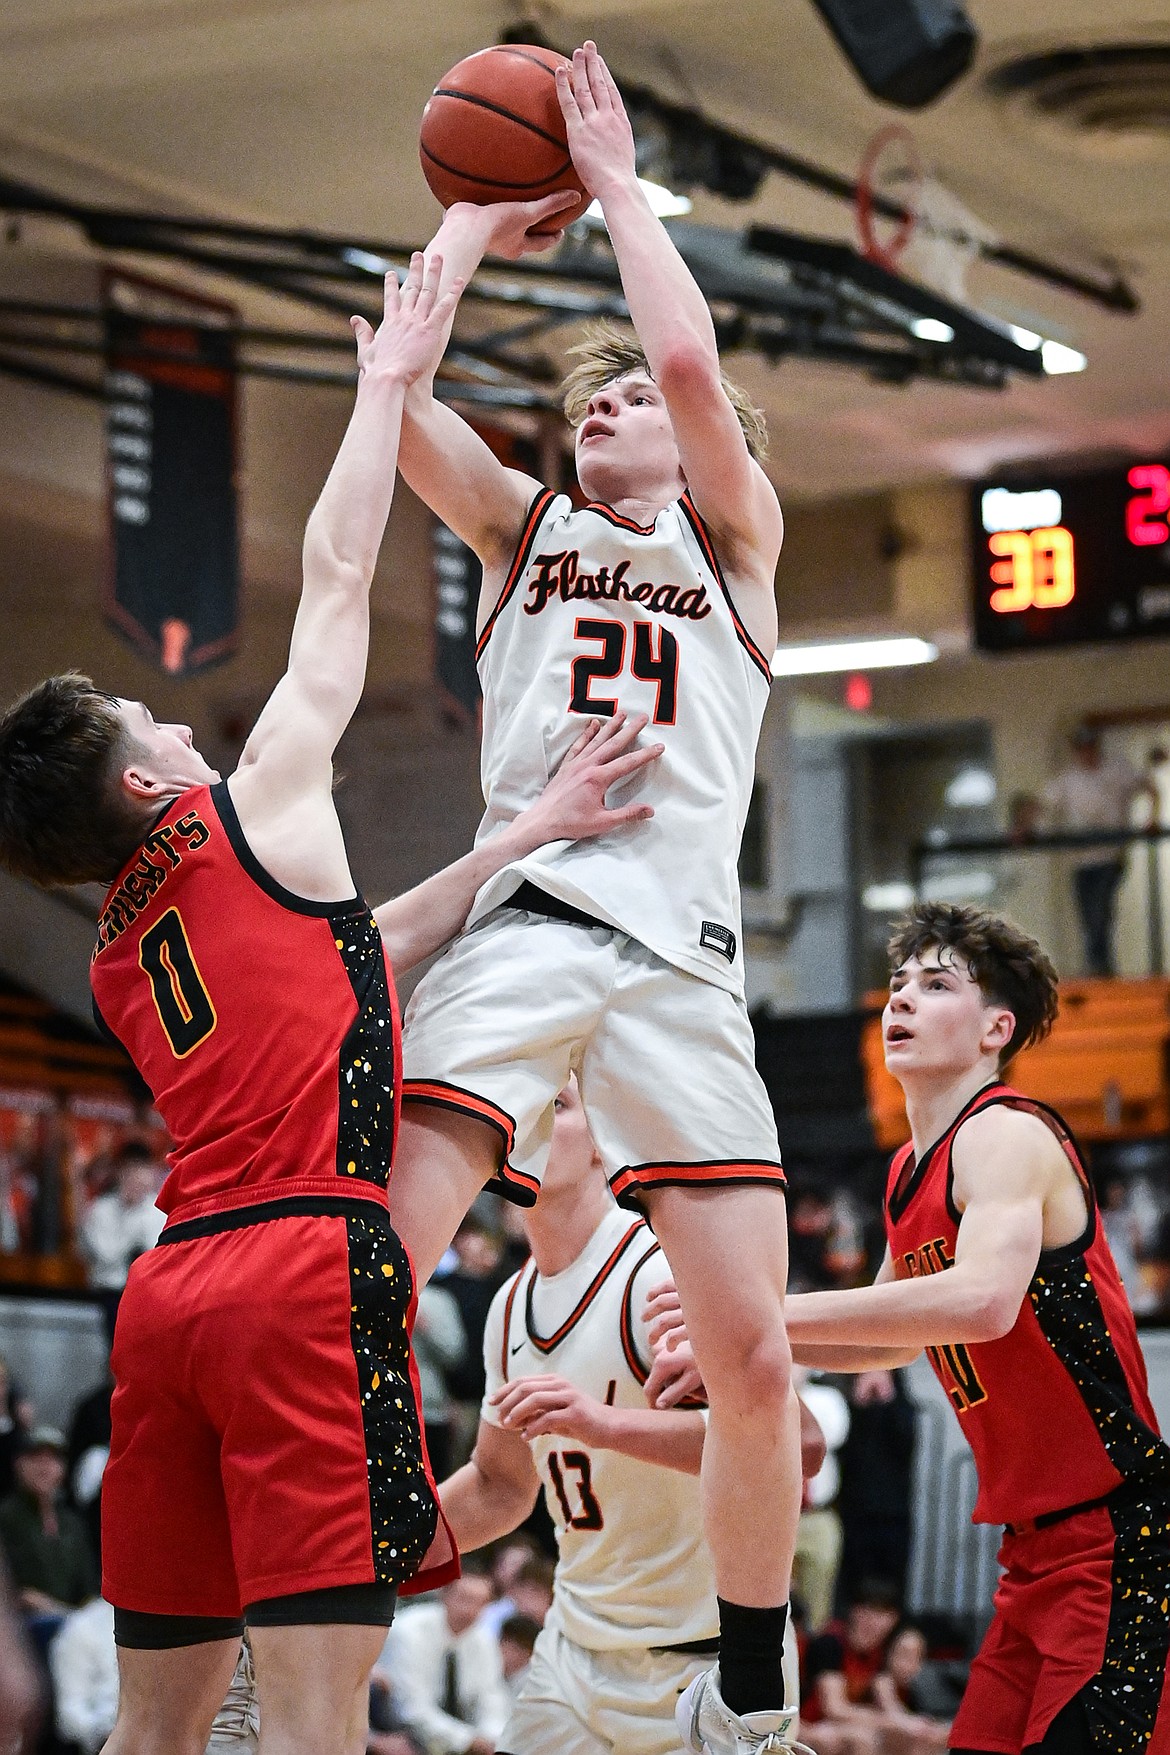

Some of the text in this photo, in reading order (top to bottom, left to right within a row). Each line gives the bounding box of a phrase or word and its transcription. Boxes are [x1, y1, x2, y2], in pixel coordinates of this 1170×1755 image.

[523, 550, 712, 620] Flathead
[568, 617, 680, 726] 24
[138, 905, 218, 1060] 0
[547, 1450, 604, 1532] 13
